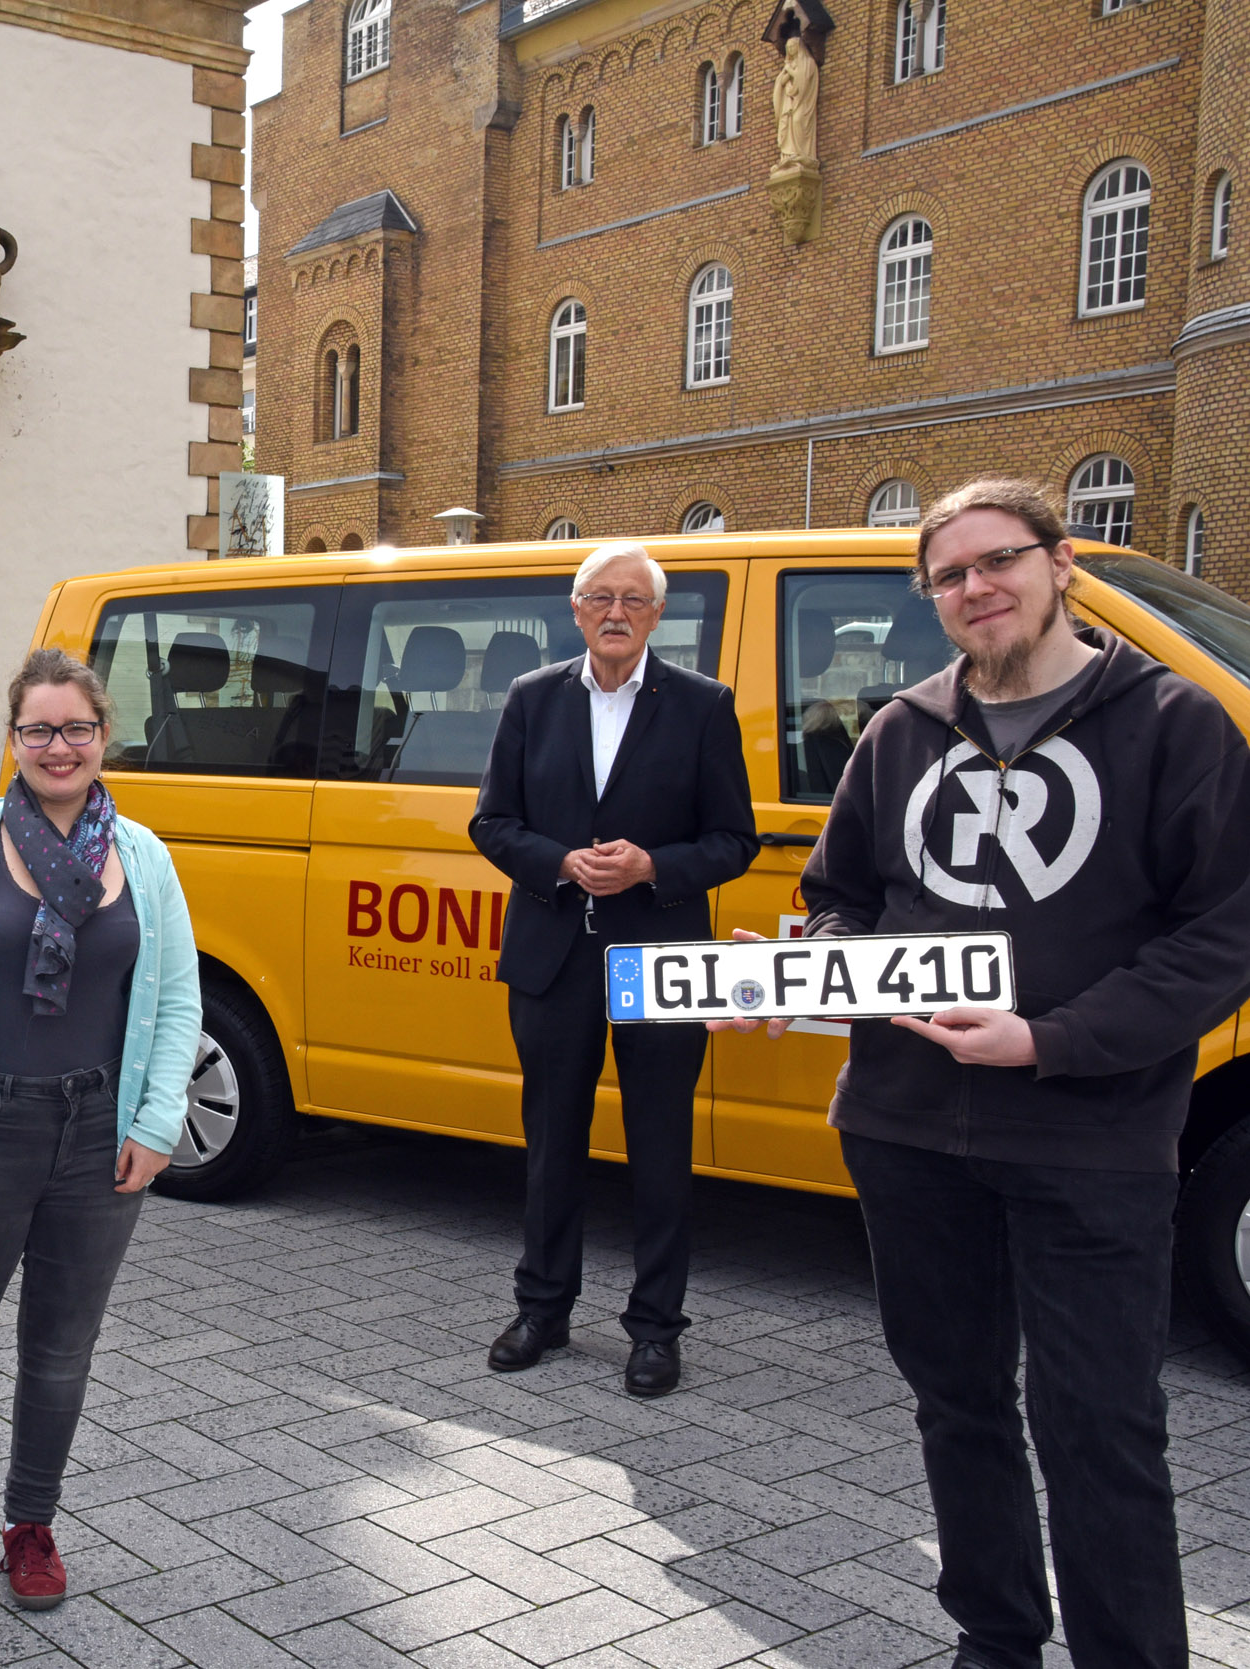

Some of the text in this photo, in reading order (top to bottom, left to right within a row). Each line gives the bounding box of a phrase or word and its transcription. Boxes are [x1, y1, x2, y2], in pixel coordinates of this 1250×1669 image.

[348, 945, 422, 973] Keiner
[430, 956, 471, 979] soll
[654, 954, 727, 1009] GI
[774, 949, 857, 1007] FA
[877, 944, 1002, 1003] 410
[621, 991, 636, 1009] D
